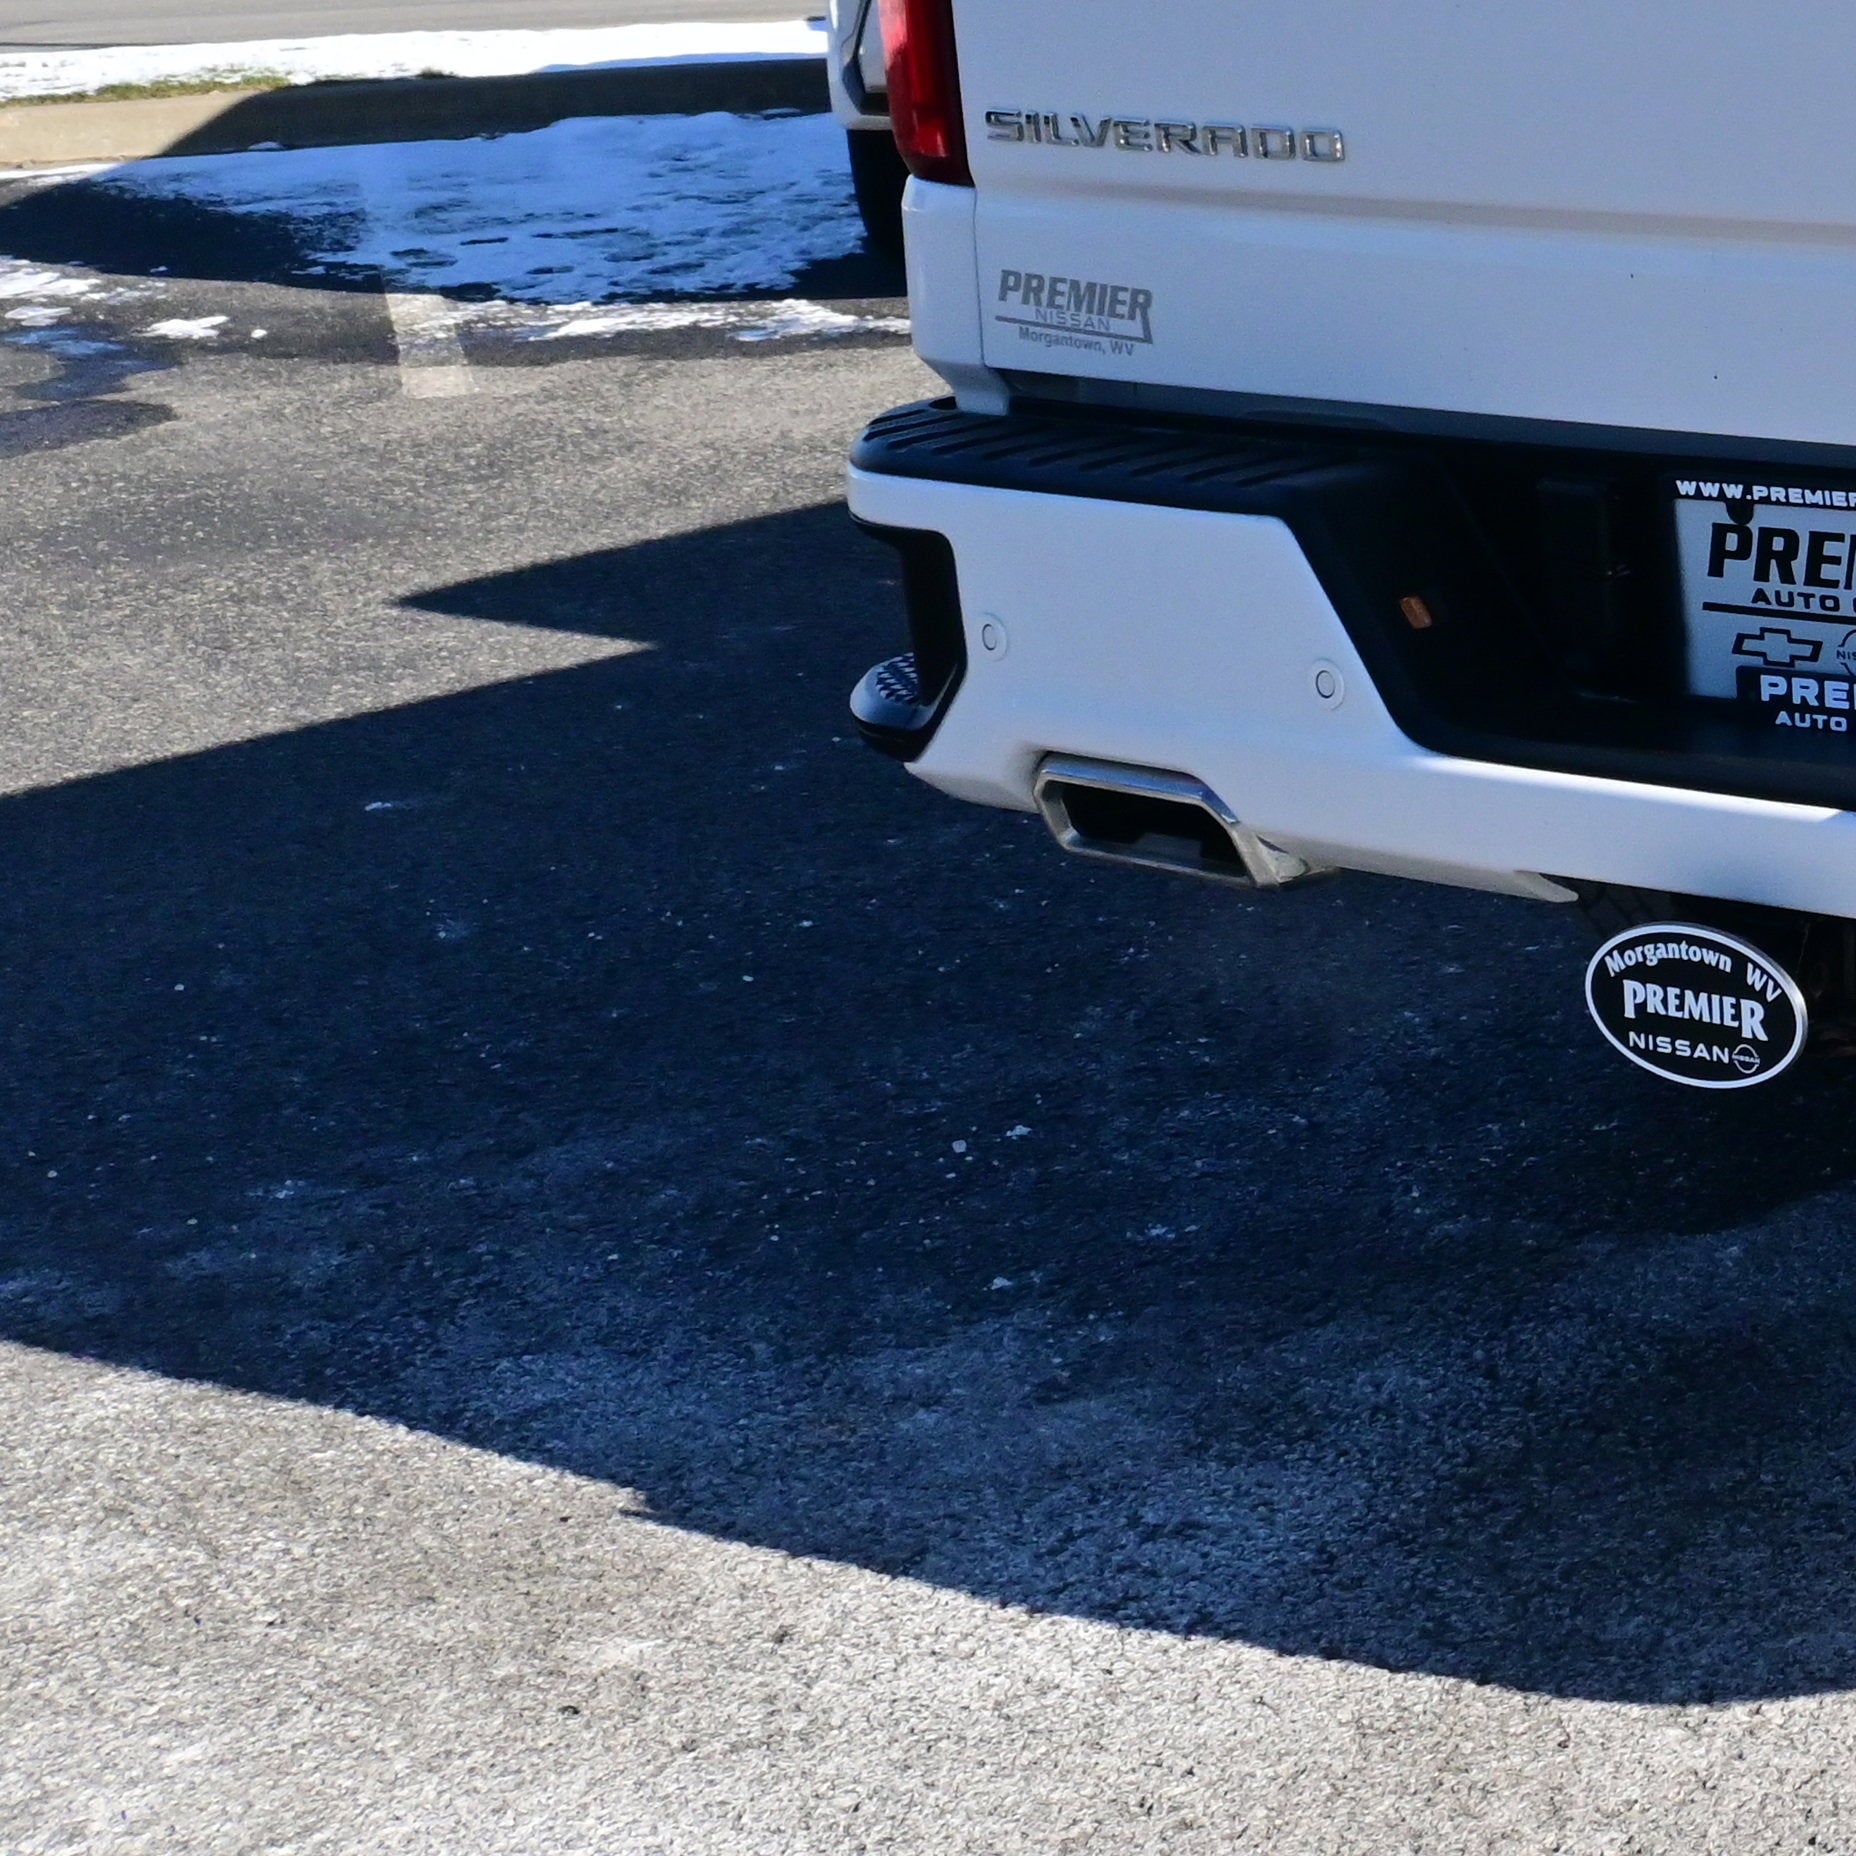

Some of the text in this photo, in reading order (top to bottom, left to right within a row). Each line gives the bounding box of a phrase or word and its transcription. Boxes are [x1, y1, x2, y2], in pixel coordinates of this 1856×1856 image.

[985, 108, 1346, 162] SILVERADO
[998, 269, 1153, 334] PREMIER
[1034, 307, 1111, 332] NISSAN
[1110, 339, 1135, 357] WV
[1751, 587, 1840, 613] AUTO
[1775, 711, 1848, 733] AUTO
[1604, 940, 1782, 1003] Morgantown WV
[1622, 978, 1768, 1042] PREMIER
[1628, 1031, 1730, 1064] NISSAN
